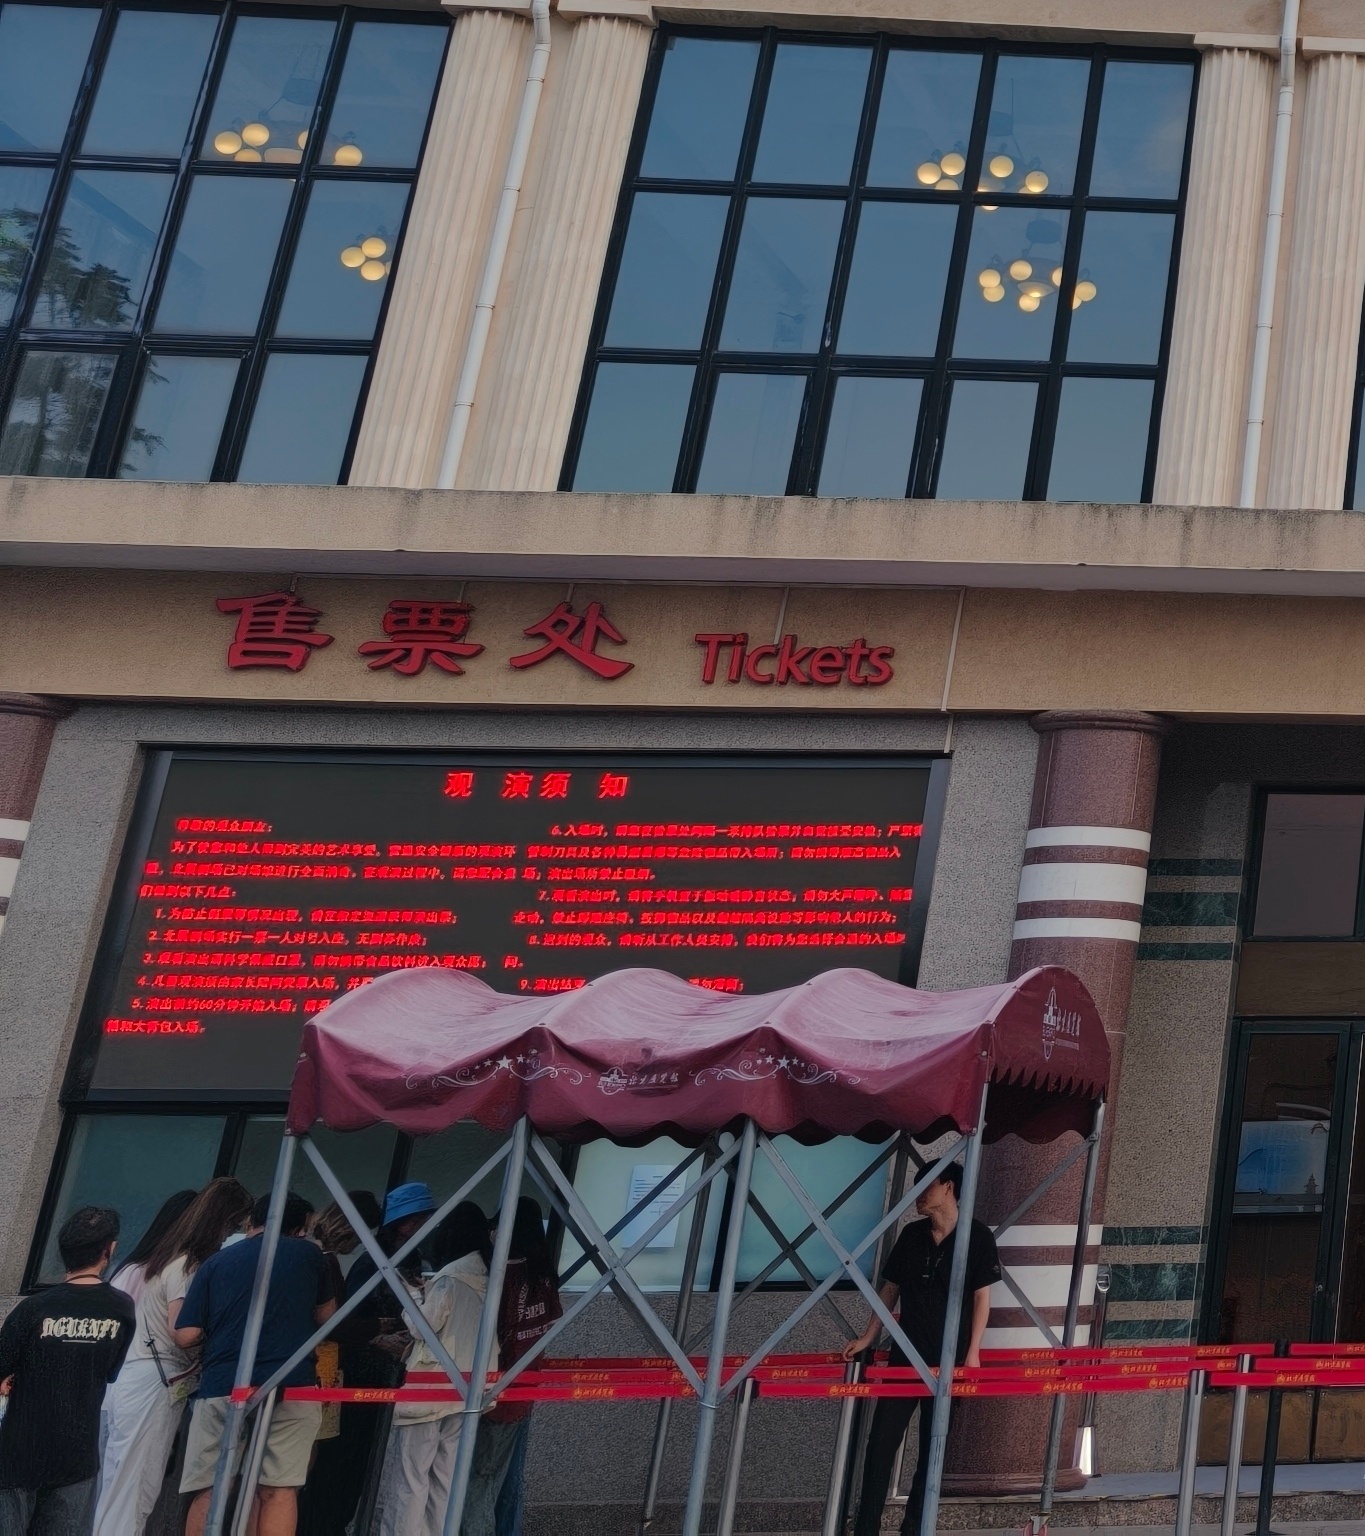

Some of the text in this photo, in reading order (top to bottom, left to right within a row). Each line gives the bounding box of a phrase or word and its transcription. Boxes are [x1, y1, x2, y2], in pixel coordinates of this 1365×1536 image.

[215, 592, 895, 686] 售票处 Tickets
